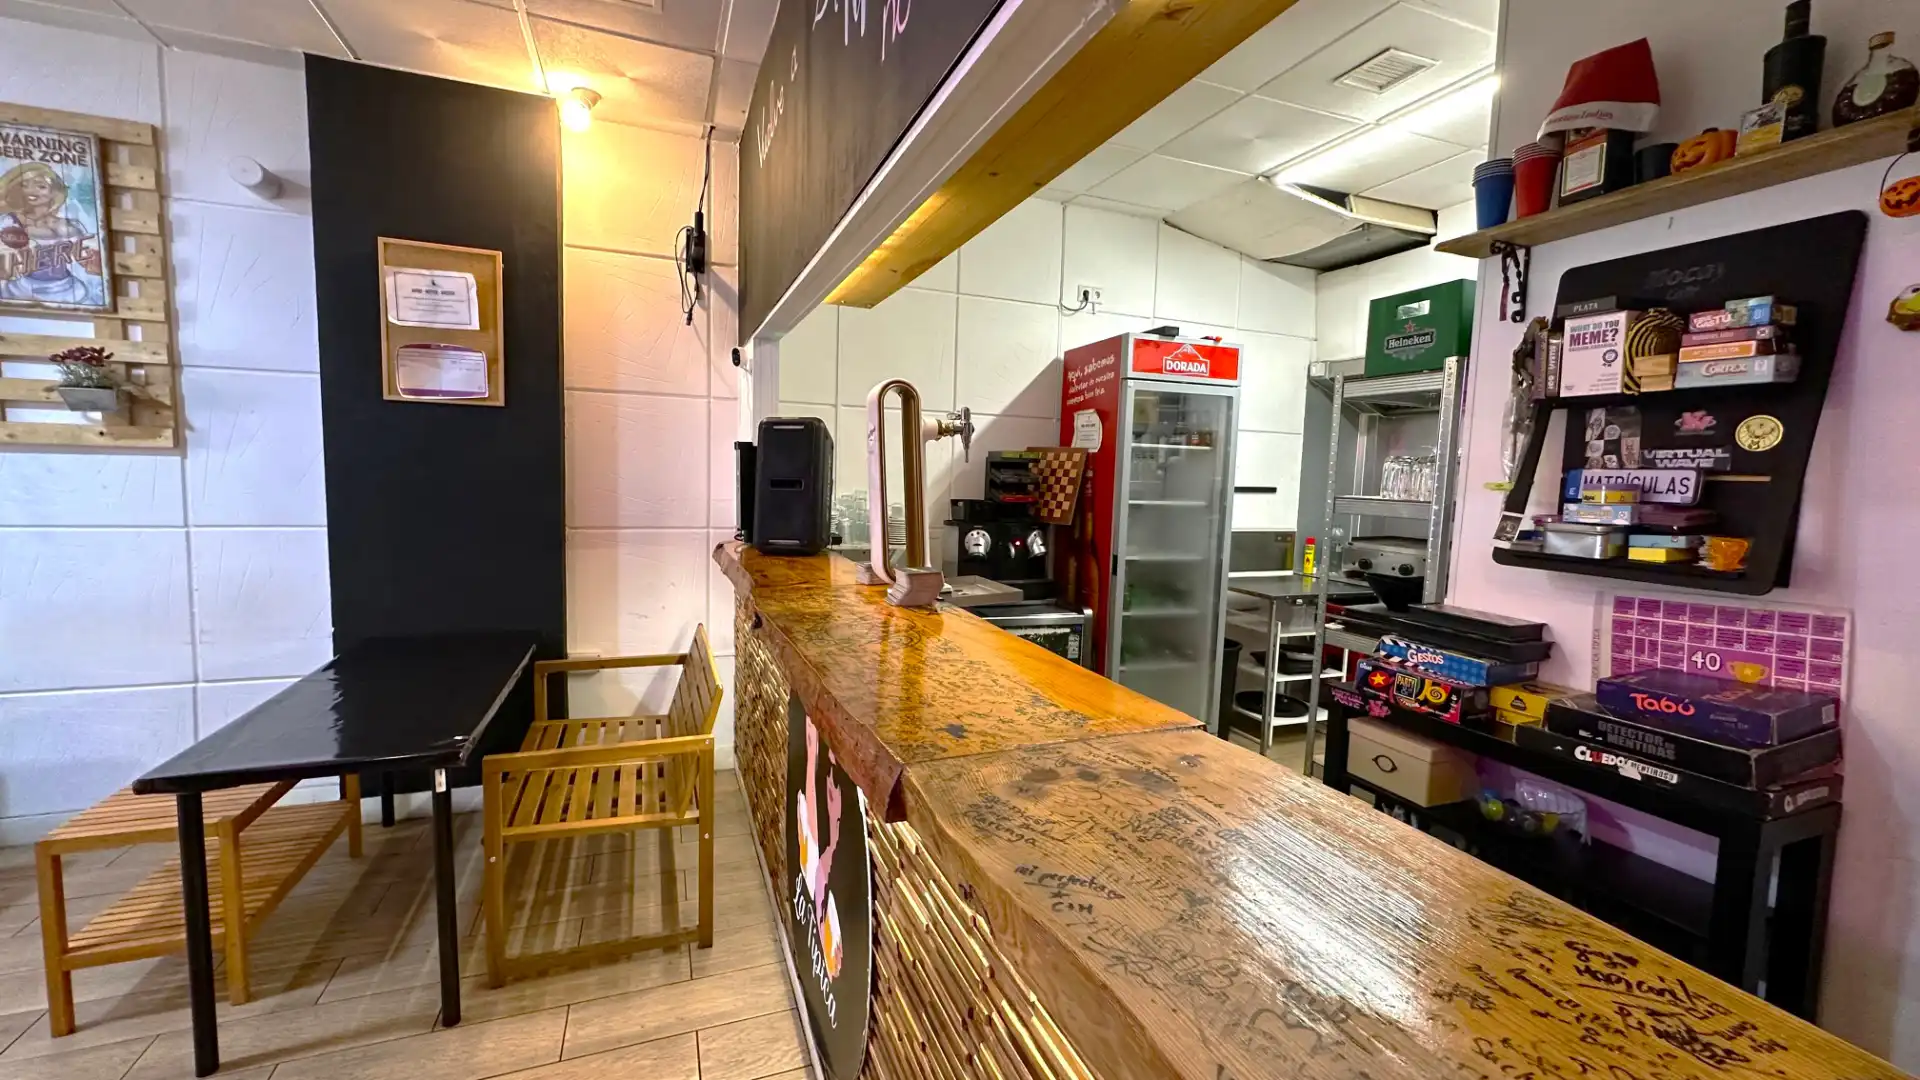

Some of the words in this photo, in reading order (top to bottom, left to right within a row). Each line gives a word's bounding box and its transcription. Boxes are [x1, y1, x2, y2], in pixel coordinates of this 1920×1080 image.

[0, 145, 36, 161] EER
[39, 149, 89, 168] ZONE
[1573, 302, 1598, 313] PLATA
[1603, 319, 1620, 329] YOU
[1387, 331, 1432, 350] Heineken
[1569, 327, 1619, 348] MEME?
[1166, 359, 1207, 373] DORADA
[1644, 448, 1730, 459] VIRTUAL
[1655, 458, 1715, 468] WAVE
[1690, 650, 1722, 672] 40
[1597, 720, 1665, 747] DETECTOR
[1573, 745, 1626, 767] CLUEDO
[1606, 733, 1677, 761] MENTIRAS
[793, 871, 808, 926] La
